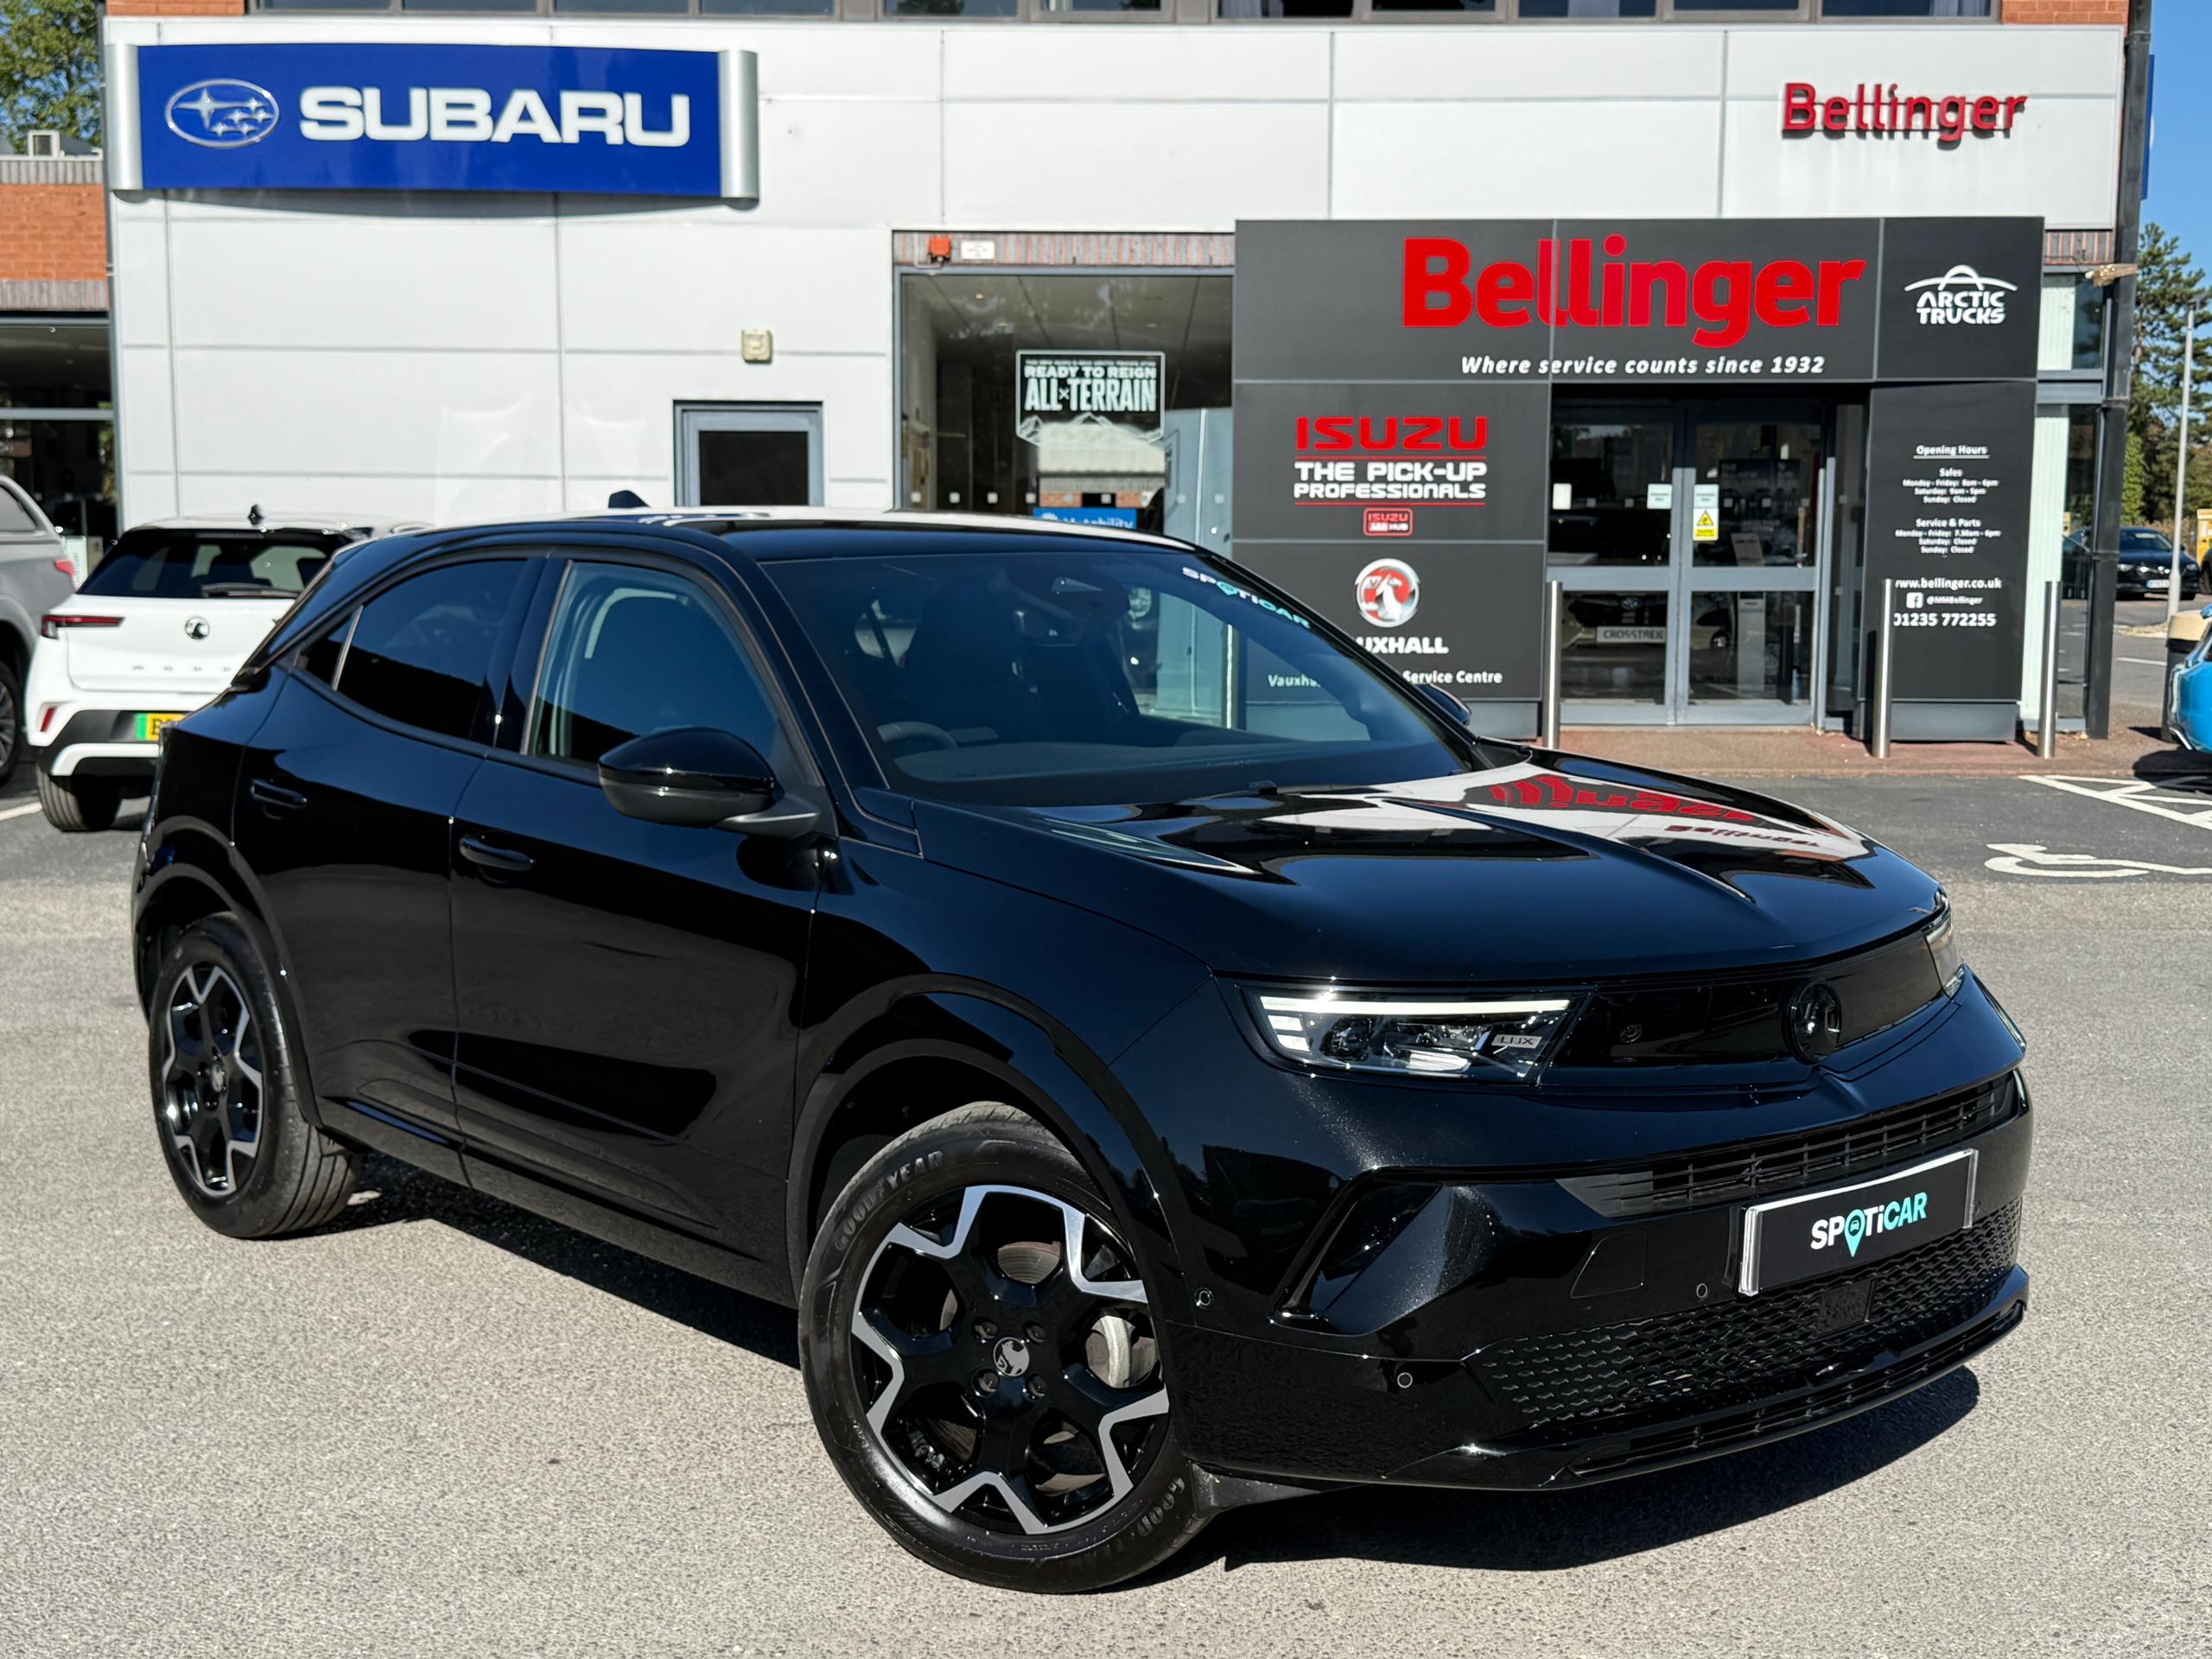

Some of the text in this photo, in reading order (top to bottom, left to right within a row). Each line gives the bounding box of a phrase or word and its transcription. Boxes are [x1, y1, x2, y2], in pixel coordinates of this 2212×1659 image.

[299, 86, 691, 148] SUBARU
[1782, 82, 2028, 142] Bellinger
[1402, 233, 1867, 349] Bellinger
[1916, 290, 2005, 308] ARCTIC
[1916, 308, 2006, 324] TRUCKS
[1461, 355, 1826, 374] Where service counts since 1932
[1024, 365, 1157, 379] READY TO REIGN
[1024, 378, 1157, 412] ALL TERRAIN
[1296, 416, 1489, 451] ISUZU
[1916, 445, 1988, 456] Opening Hours
[1294, 461, 1488, 482] THE PICK-UP
[1939, 467, 1963, 477] Sales
[1903, 479, 1931, 487] Monday
[1294, 483, 1487, 499] PROFESSIONALS
[1953, 495, 1978, 504] Closed
[1368, 513, 1408, 522] ISUZU
[1916, 518, 1982, 528] Service & Parts
[1895, 529, 1923, 537] Monday
[1893, 613, 1998, 626] 01235 772255
[1603, 629, 1664, 639] CROSSTREK
[1356, 637, 1450, 654] UXHALL
[1268, 674, 1321, 688] Vauxha
[1402, 670, 1503, 684] Service Centre
